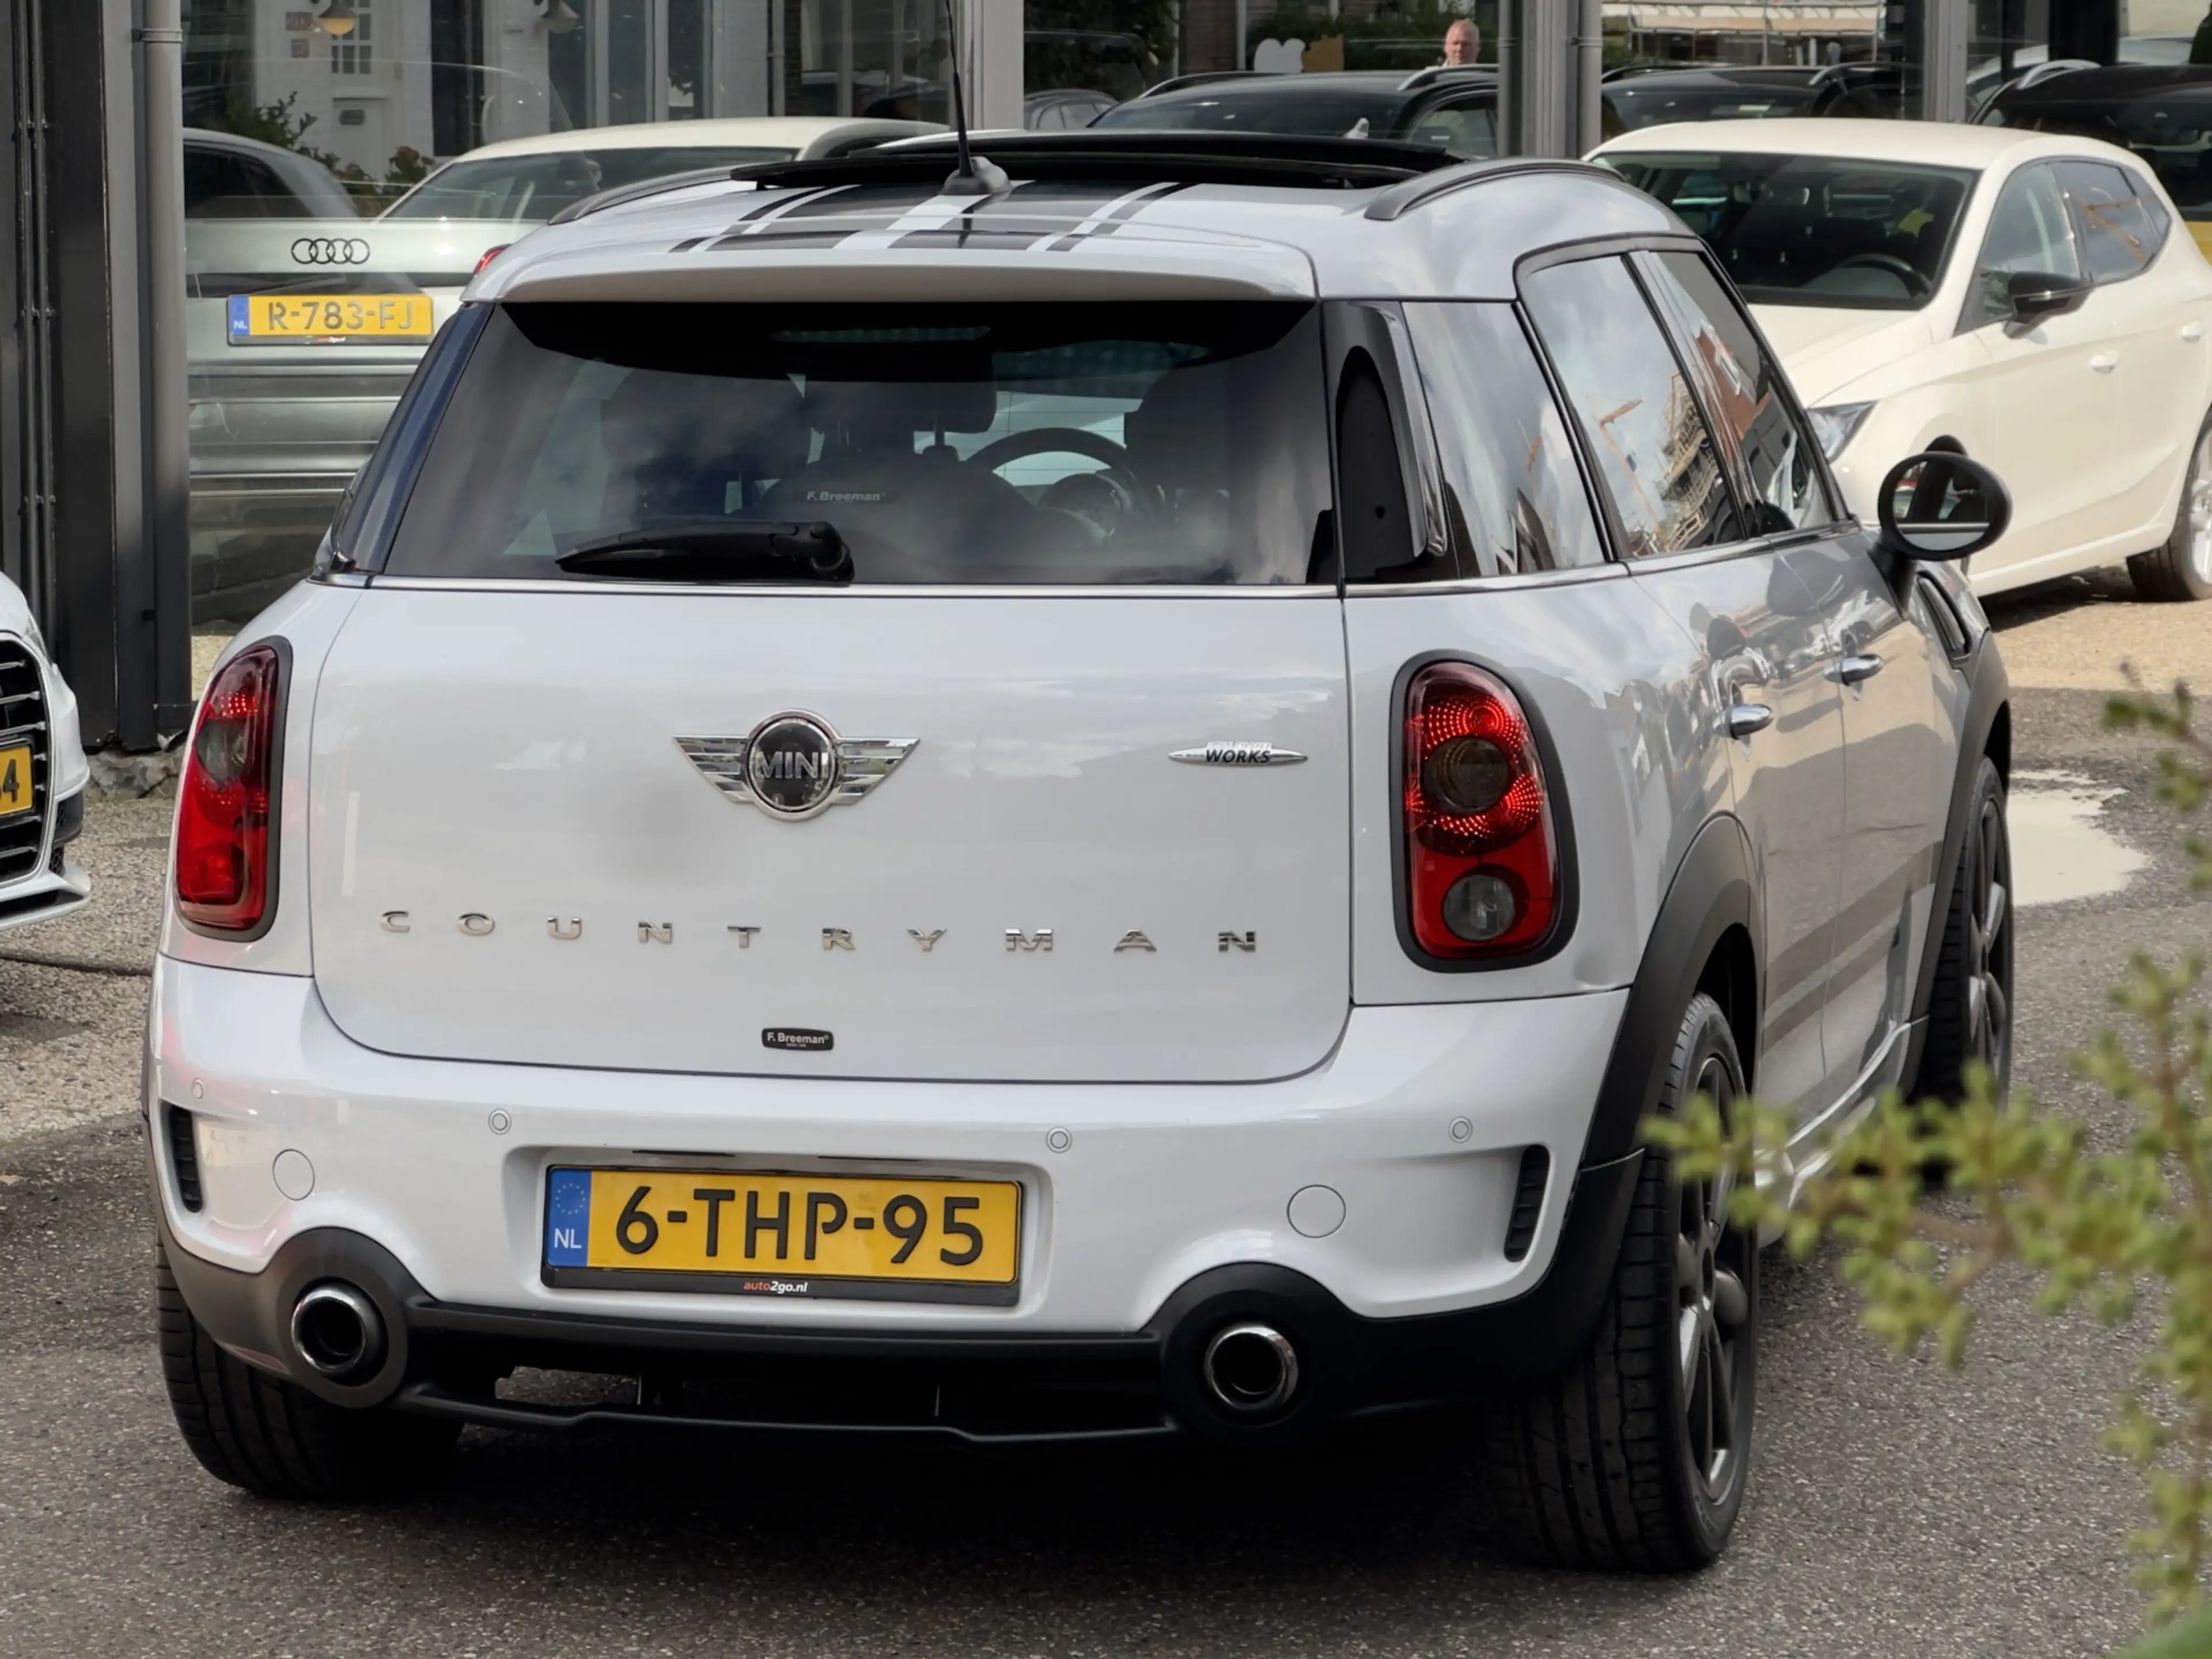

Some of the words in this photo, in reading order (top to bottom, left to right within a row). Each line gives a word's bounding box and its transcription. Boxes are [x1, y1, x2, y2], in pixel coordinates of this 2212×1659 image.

[233, 319, 248, 330] NL
[268, 301, 413, 331] R-783-FJ
[755, 751, 830, 779] MINI
[1205, 749, 1271, 764] WORKS
[0, 758, 20, 803] 4
[379, 910, 1256, 953] COUNTRYMAN
[767, 1032, 777, 1042] F.
[777, 1032, 825, 1044] Breeman
[615, 1185, 984, 1266] 6-THP-95
[554, 1229, 582, 1249] NL
[743, 1280, 809, 1294] auto2go.nl
